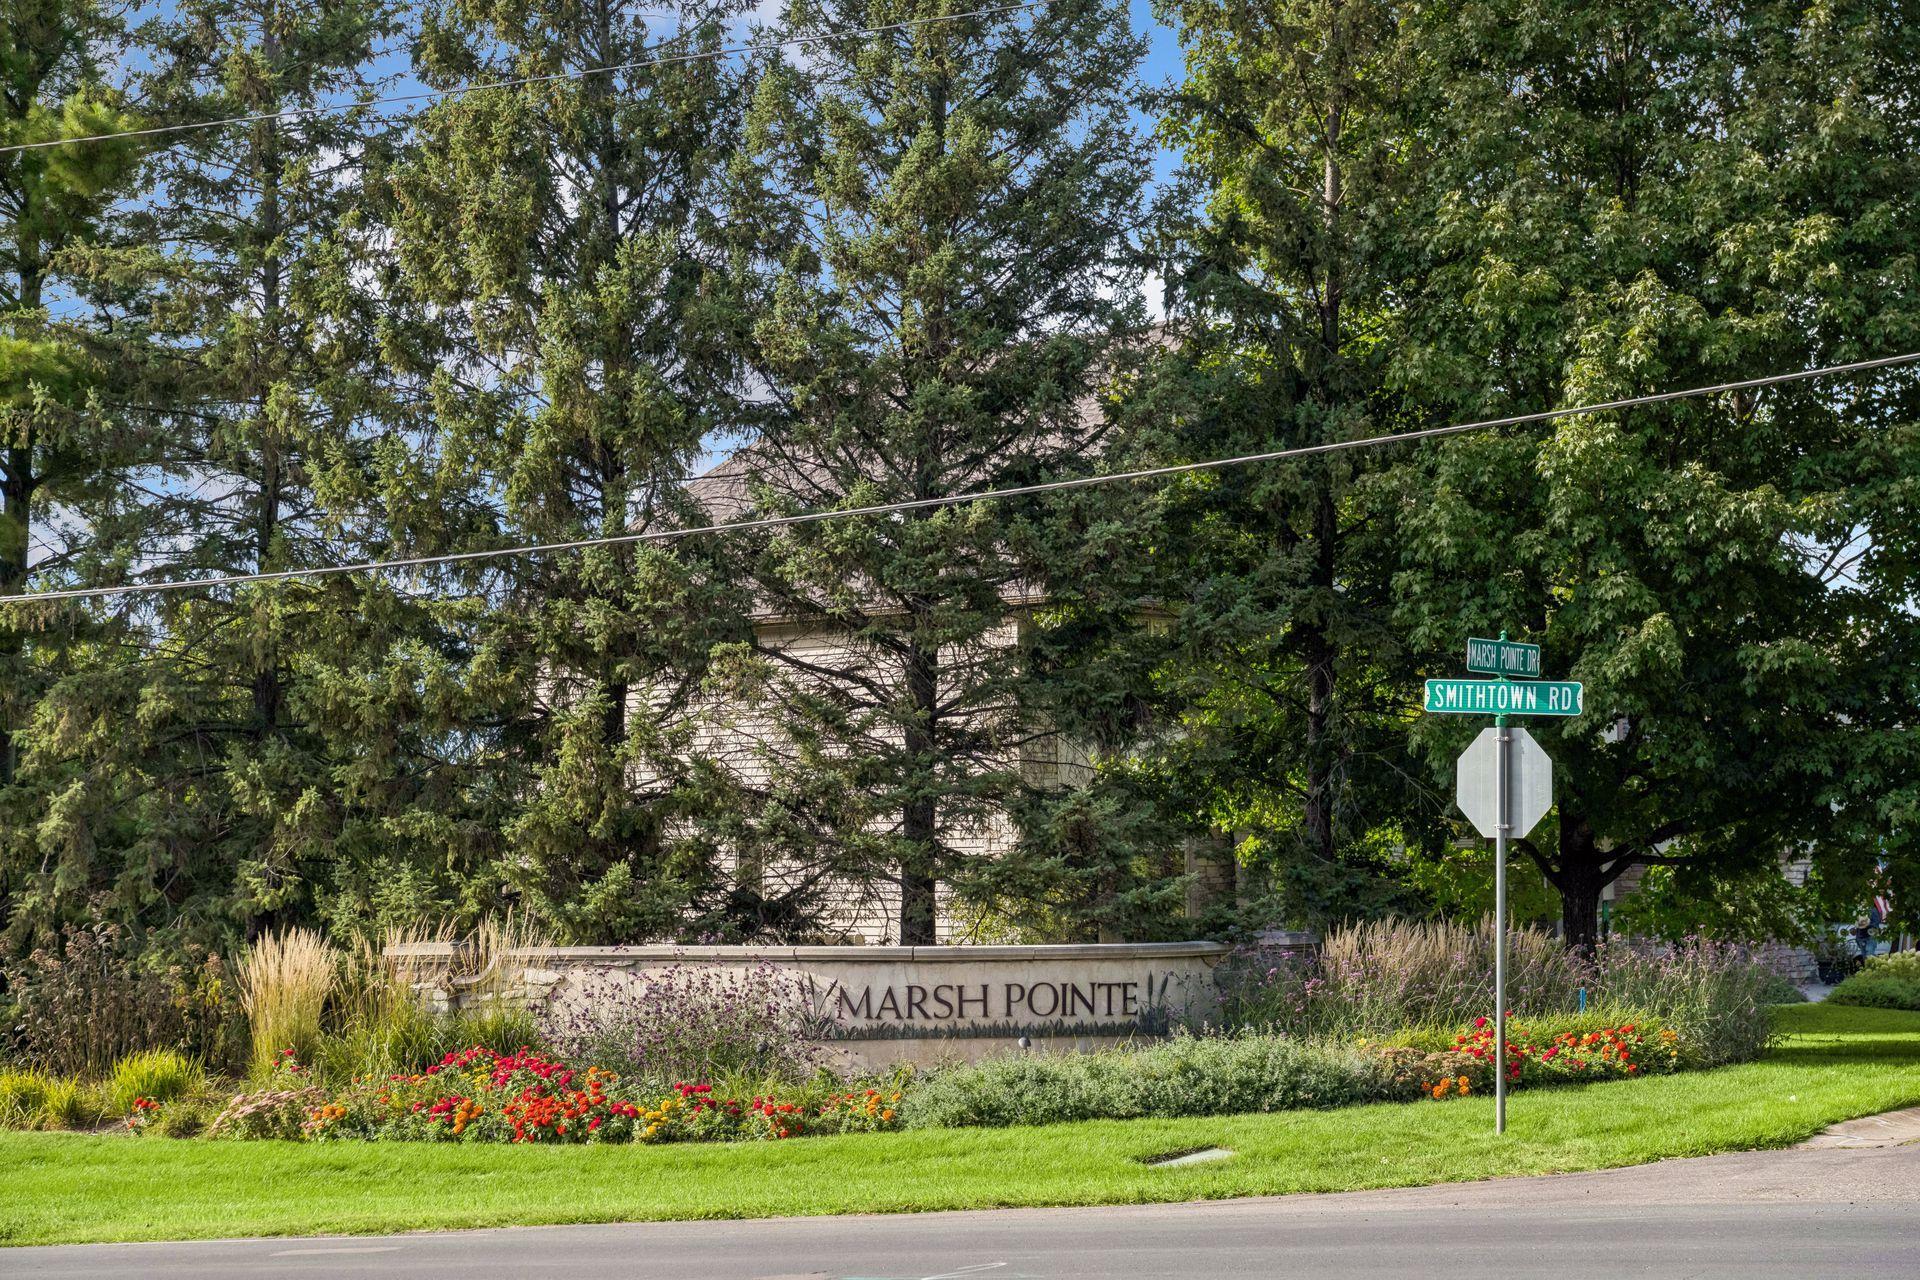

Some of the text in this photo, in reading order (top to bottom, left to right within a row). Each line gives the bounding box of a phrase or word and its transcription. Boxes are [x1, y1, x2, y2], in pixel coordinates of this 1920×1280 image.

[1470, 643, 1537, 672] MARSH POINTE DR
[1435, 684, 1572, 711] SMITHTOWN RD
[838, 981, 1139, 1020] MARSH POINTE
